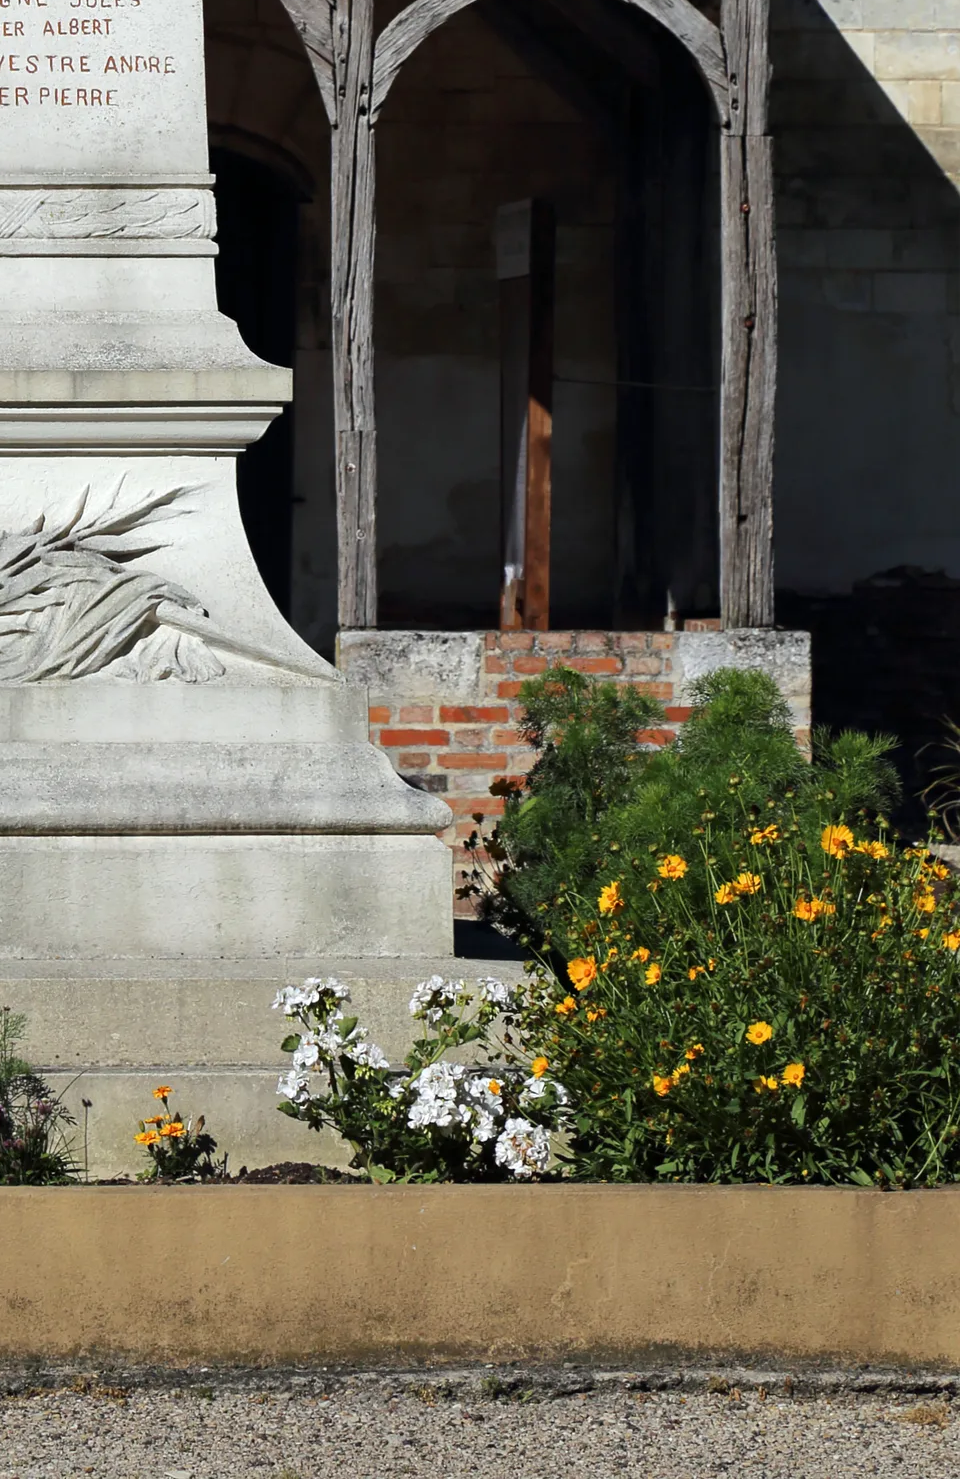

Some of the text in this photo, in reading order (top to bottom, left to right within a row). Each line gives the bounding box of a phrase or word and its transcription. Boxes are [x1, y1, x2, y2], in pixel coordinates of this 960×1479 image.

[43, 19, 113, 36] ALBERT
[104, 55, 177, 74] ANDRE
[39, 87, 119, 107] PIERRE
